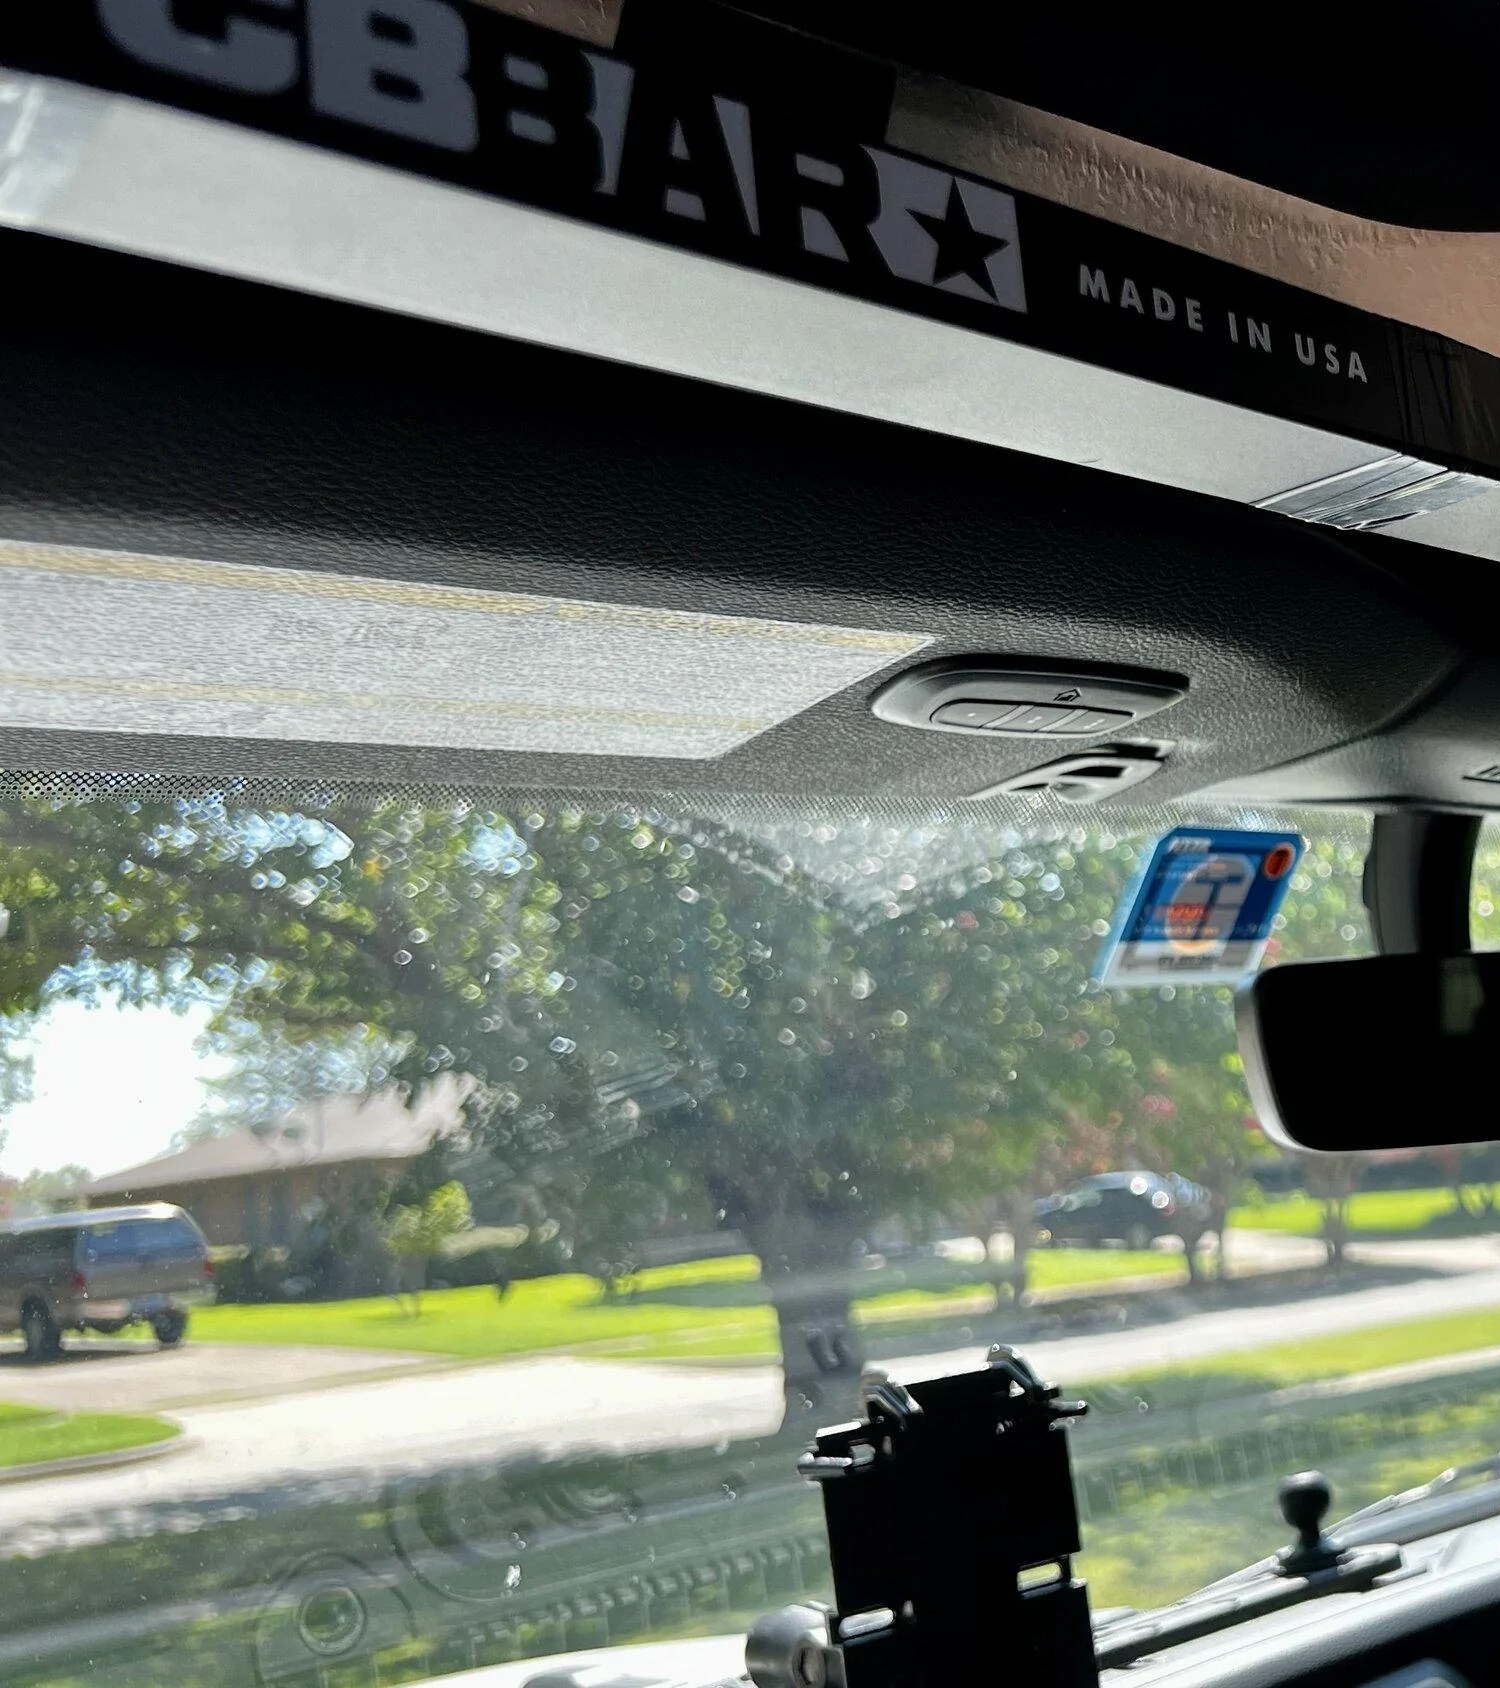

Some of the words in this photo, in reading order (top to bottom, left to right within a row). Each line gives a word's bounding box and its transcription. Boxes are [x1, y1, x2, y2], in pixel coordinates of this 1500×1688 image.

[1079, 263, 1204, 334] MADE
[1226, 310, 1273, 354] IN
[1294, 332, 1369, 384] USA
